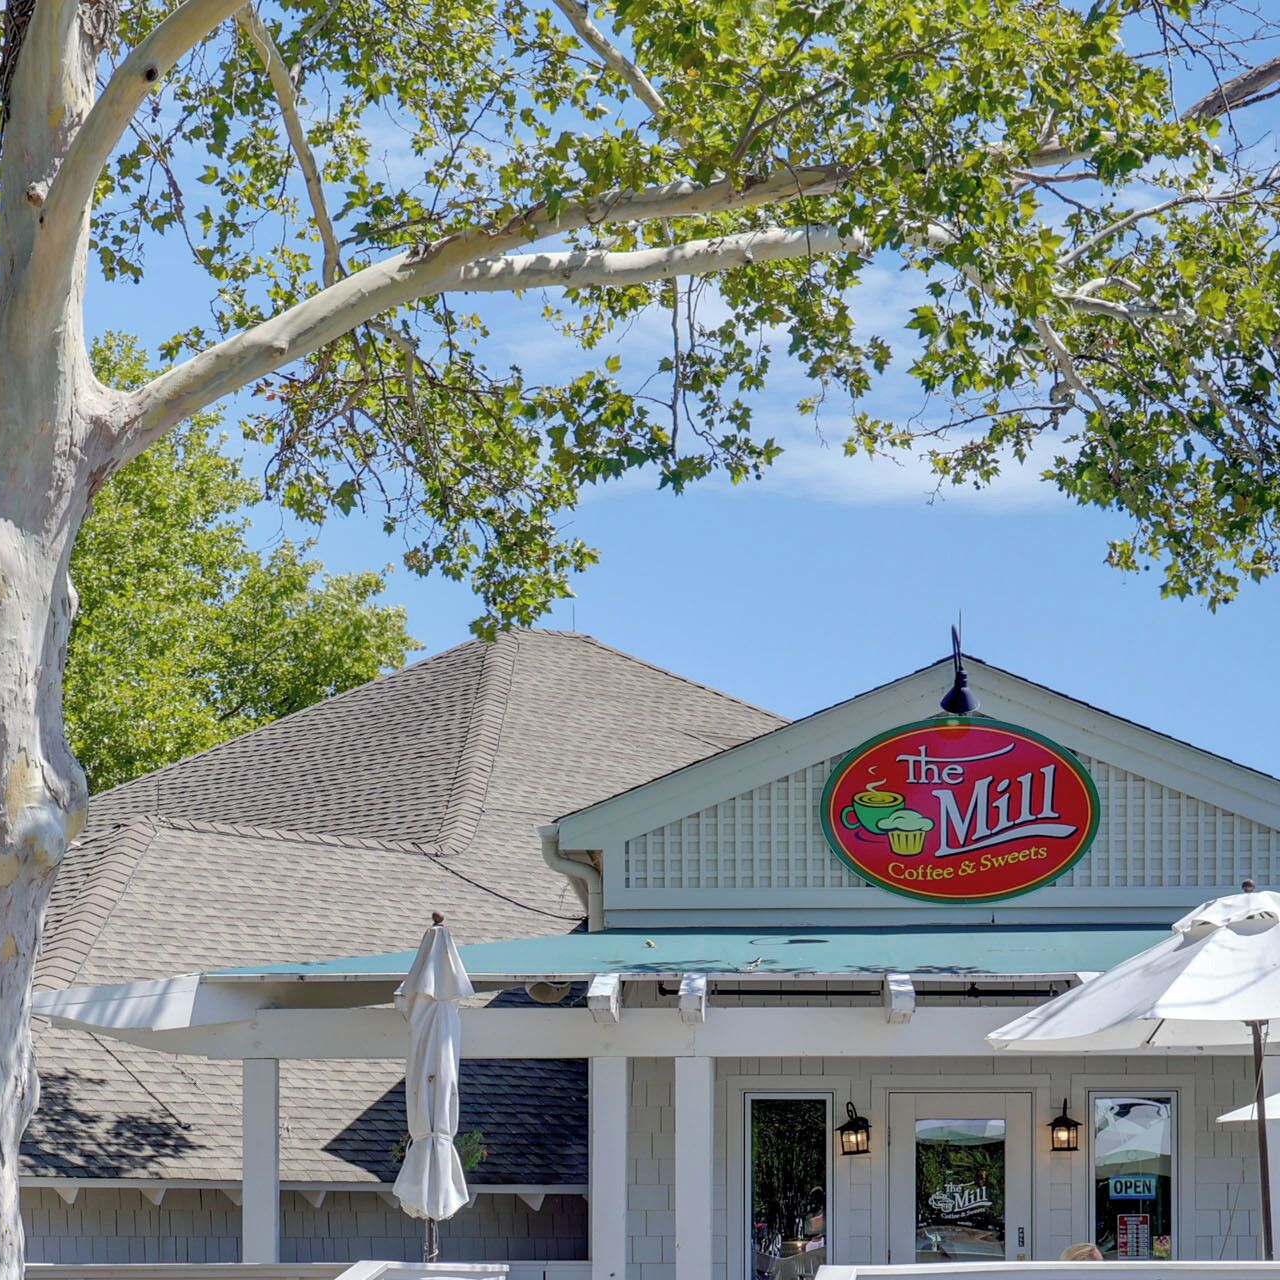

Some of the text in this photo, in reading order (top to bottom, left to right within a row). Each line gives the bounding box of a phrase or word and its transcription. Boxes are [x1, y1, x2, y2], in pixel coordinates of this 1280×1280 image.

[896, 743, 1014, 784] The
[932, 764, 1077, 857] Mill
[888, 846, 1048, 881] Coffee & Sweets
[953, 1186, 993, 1212] Mill
[1114, 1180, 1152, 1194] OPEN
